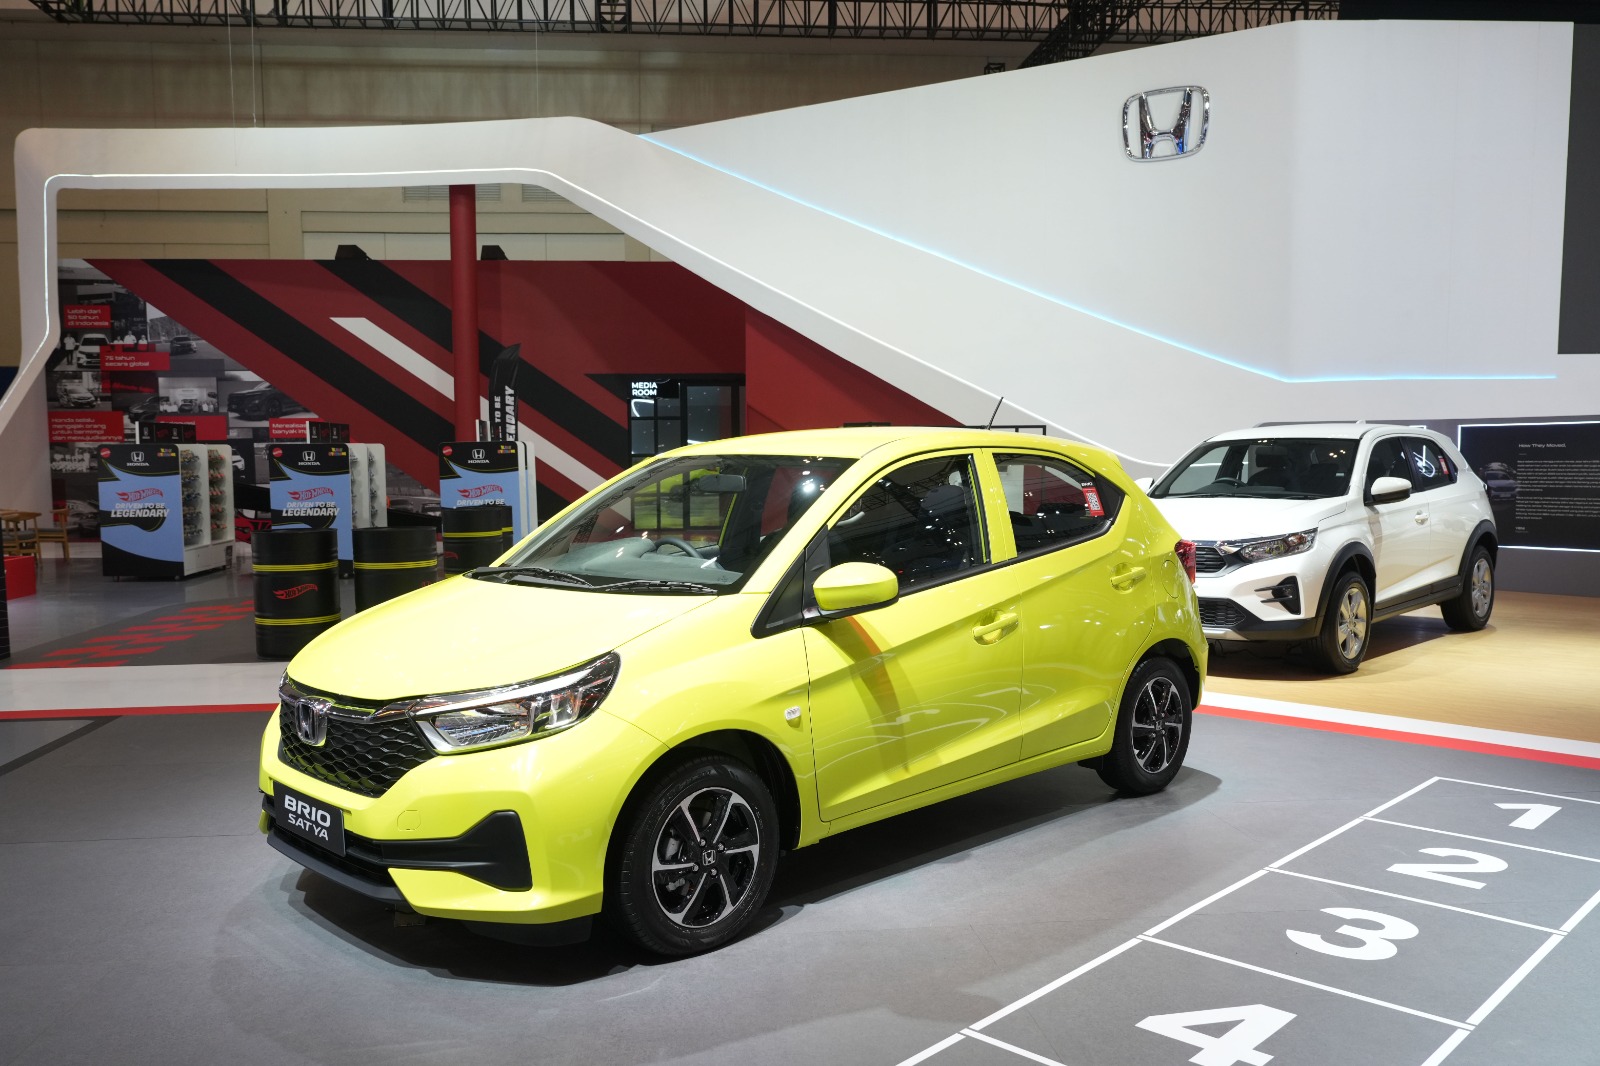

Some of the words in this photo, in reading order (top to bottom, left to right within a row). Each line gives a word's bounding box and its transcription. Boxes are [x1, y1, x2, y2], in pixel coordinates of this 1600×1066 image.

[494, 396, 501, 408] BE
[494, 410, 502, 422] TO
[111, 510, 170, 518] LEGENDARY
[282, 508, 340, 516] LEGENDARY
[284, 794, 331, 828] BRIO
[1494, 803, 1562, 830] 1
[288, 814, 328, 841] SATYA
[1386, 848, 1508, 890] 2
[1286, 908, 1420, 960] 3
[1135, 1004, 1298, 1066] 4
